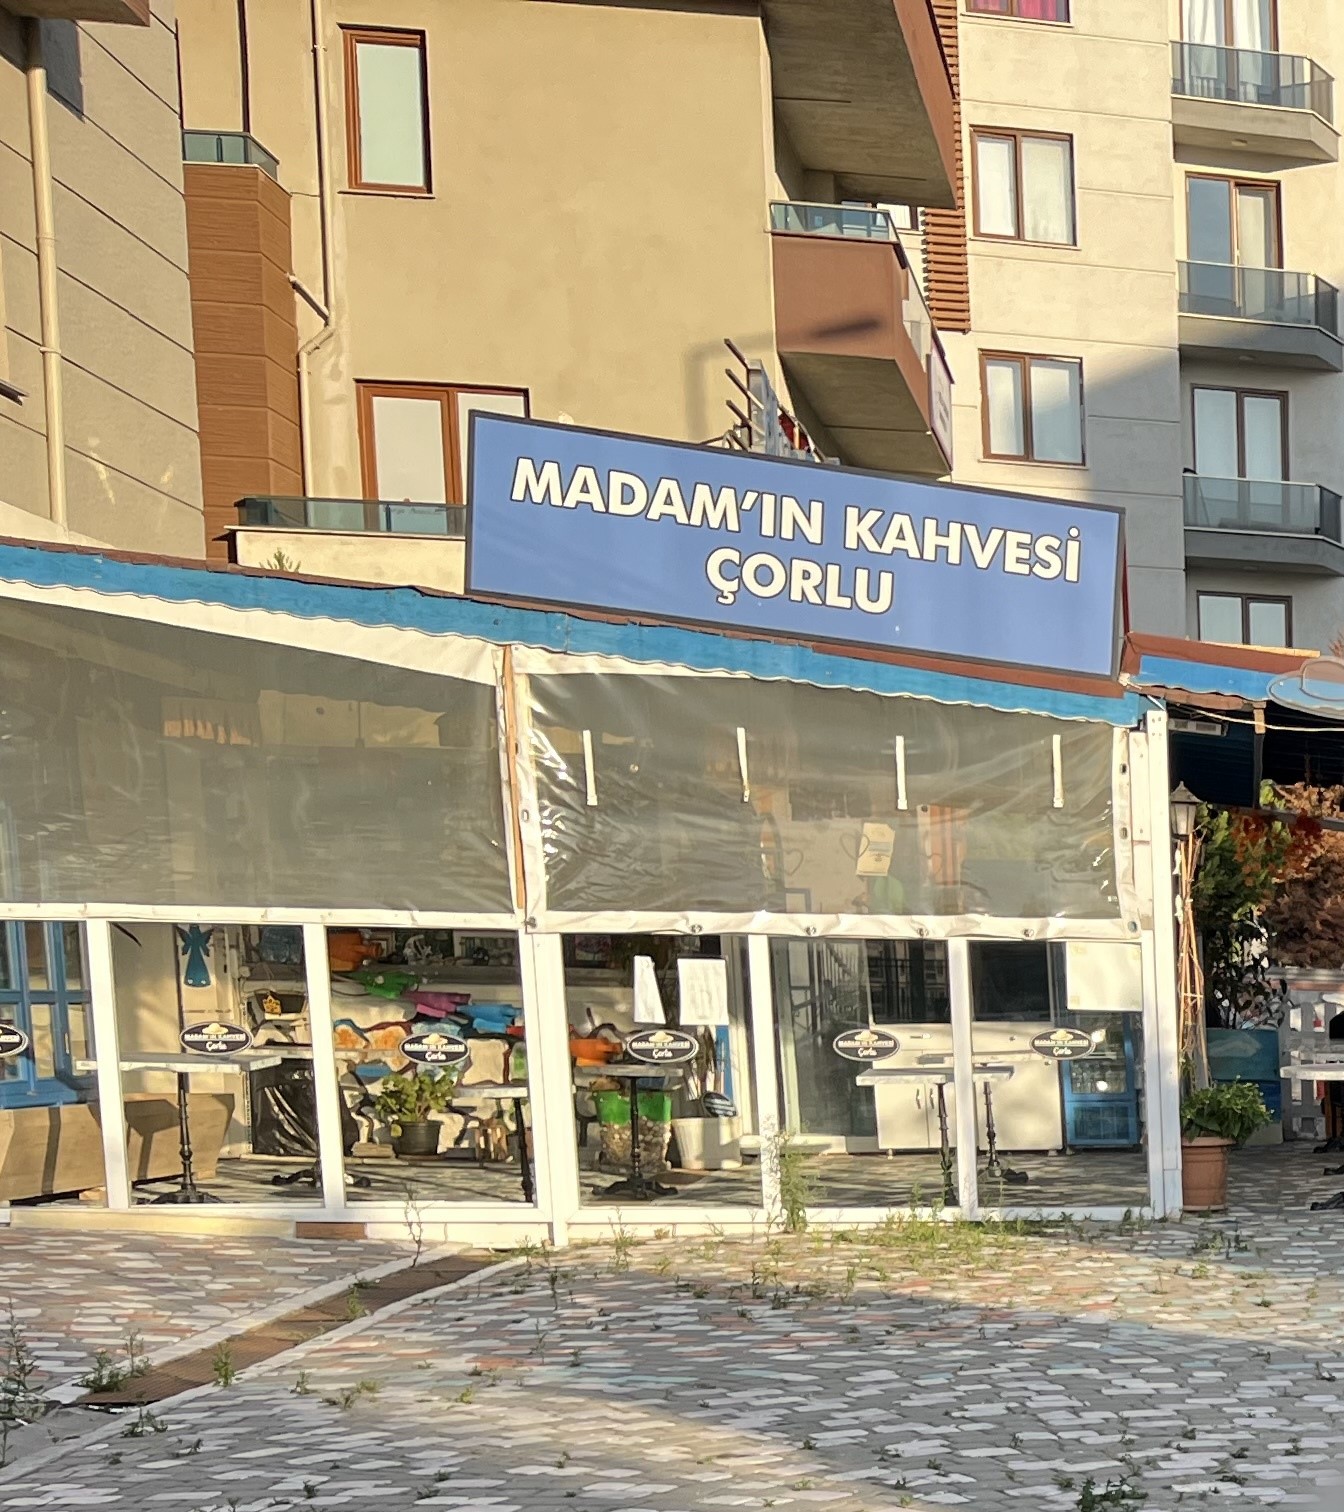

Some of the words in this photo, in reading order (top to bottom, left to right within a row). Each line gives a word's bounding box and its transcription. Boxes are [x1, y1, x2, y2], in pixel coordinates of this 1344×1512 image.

[509, 456, 825, 546] MADAM'IN
[843, 505, 1083, 583] KAHVESİ
[705, 547, 895, 614] ÇORLU
